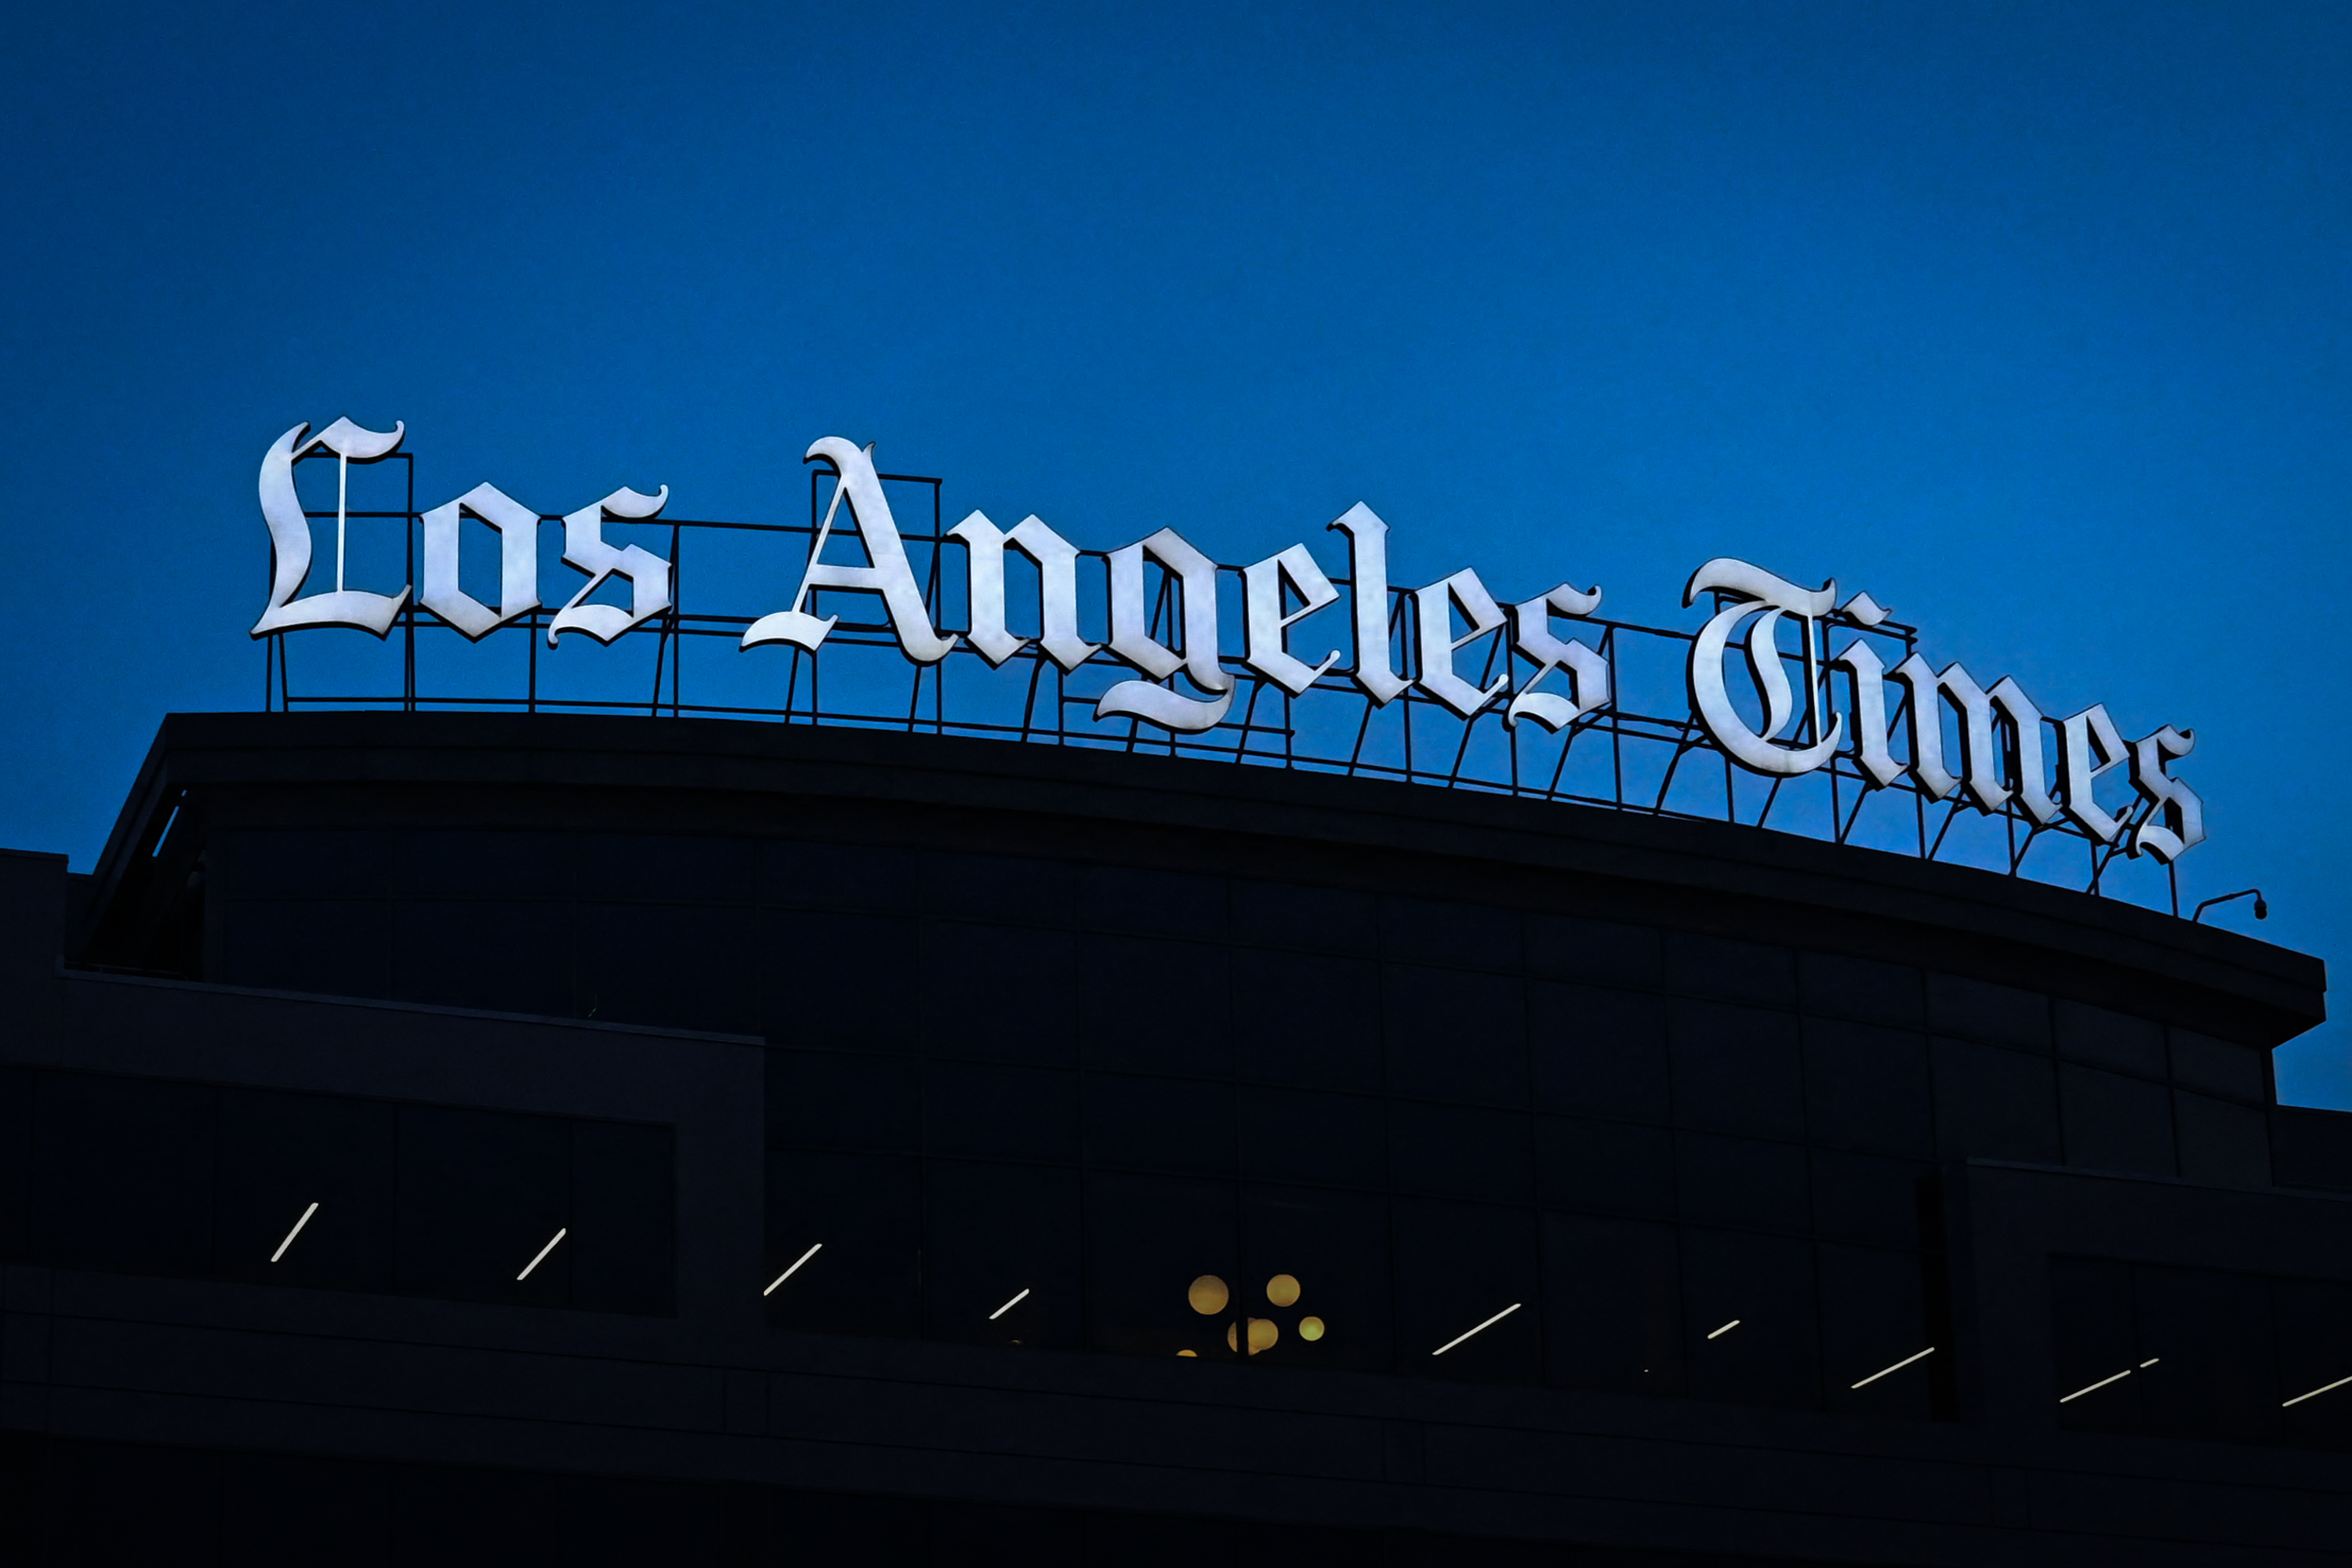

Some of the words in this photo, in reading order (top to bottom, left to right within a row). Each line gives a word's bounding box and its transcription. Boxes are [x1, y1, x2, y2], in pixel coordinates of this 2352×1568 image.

[252, 416, 672, 644] Los
[740, 436, 1611, 731] Angeles
[1686, 557, 2205, 862] Times
